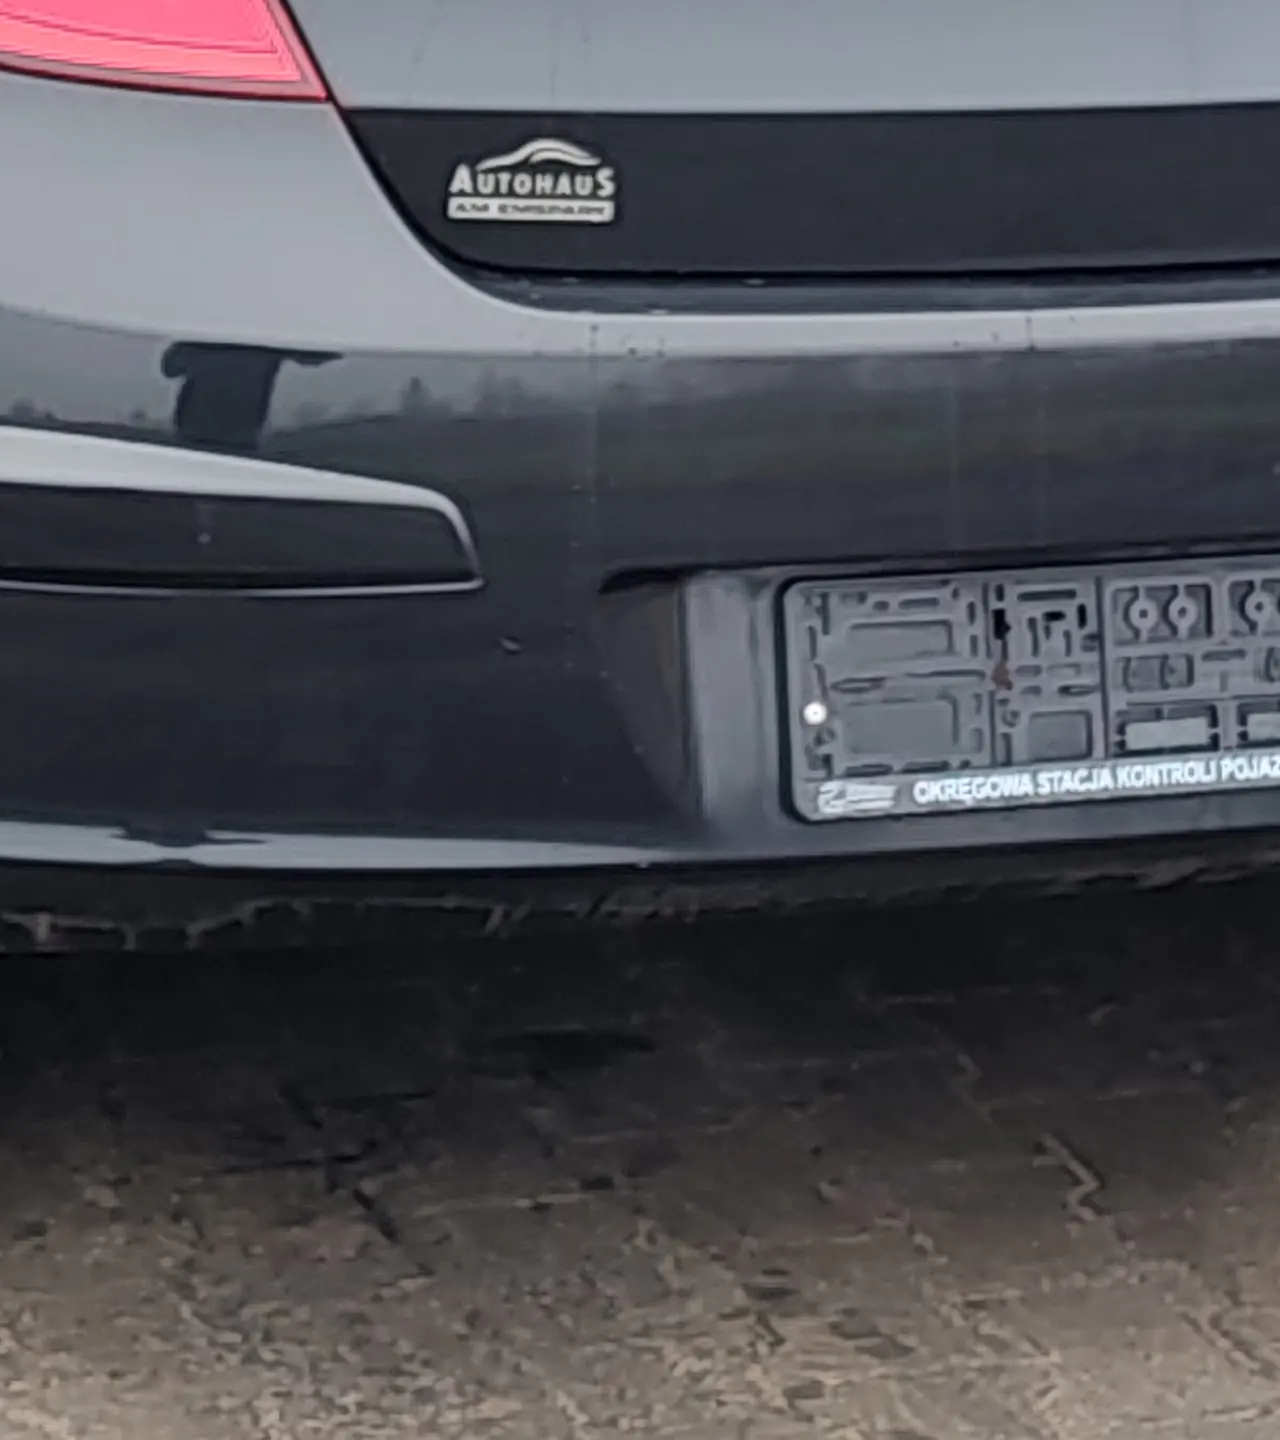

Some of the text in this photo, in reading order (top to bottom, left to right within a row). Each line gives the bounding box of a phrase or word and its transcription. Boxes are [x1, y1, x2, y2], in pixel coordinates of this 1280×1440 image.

[448, 163, 616, 198] AUTOHAUS
[913, 771, 1035, 806] OKRĘGOWA
[1037, 766, 1113, 795] STACJA
[1116, 760, 1218, 788] KONTROLI
